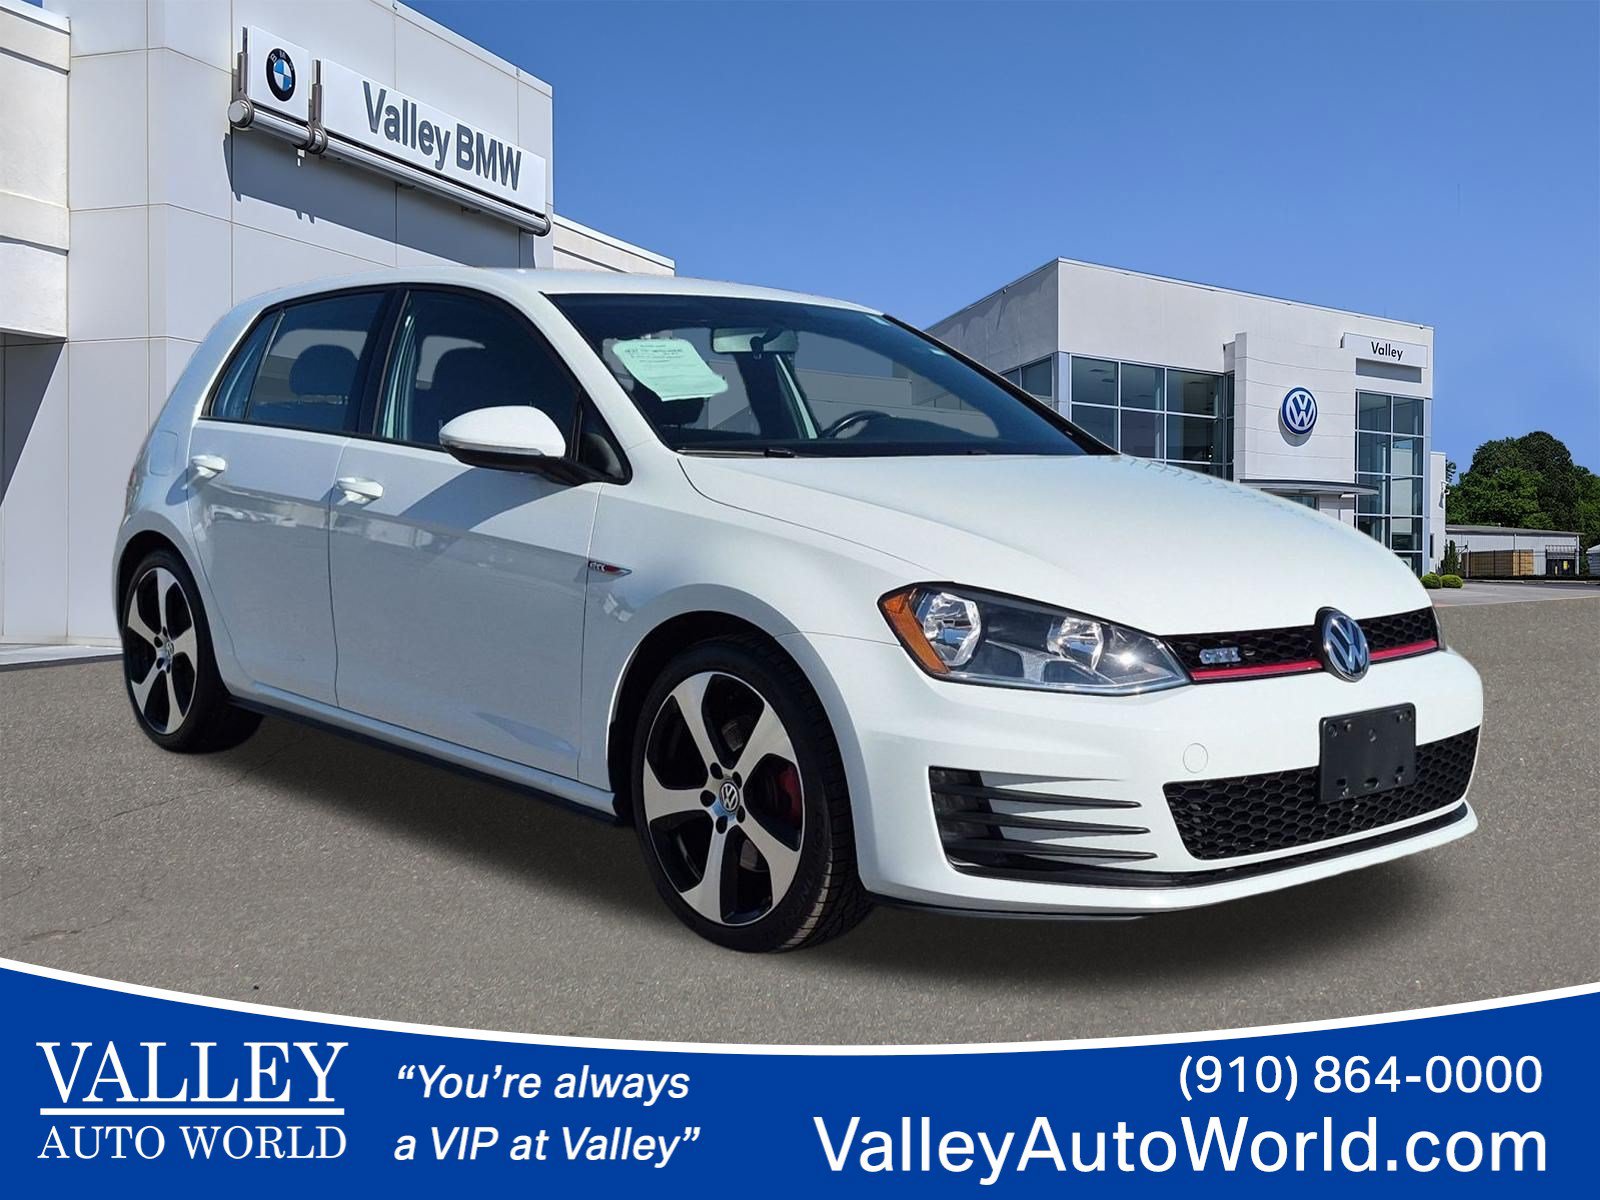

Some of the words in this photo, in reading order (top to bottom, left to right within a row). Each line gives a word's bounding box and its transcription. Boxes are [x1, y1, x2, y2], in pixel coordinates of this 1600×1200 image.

[362, 80, 450, 171] Valley
[455, 123, 522, 192] BMW
[1371, 341, 1404, 361] Valley
